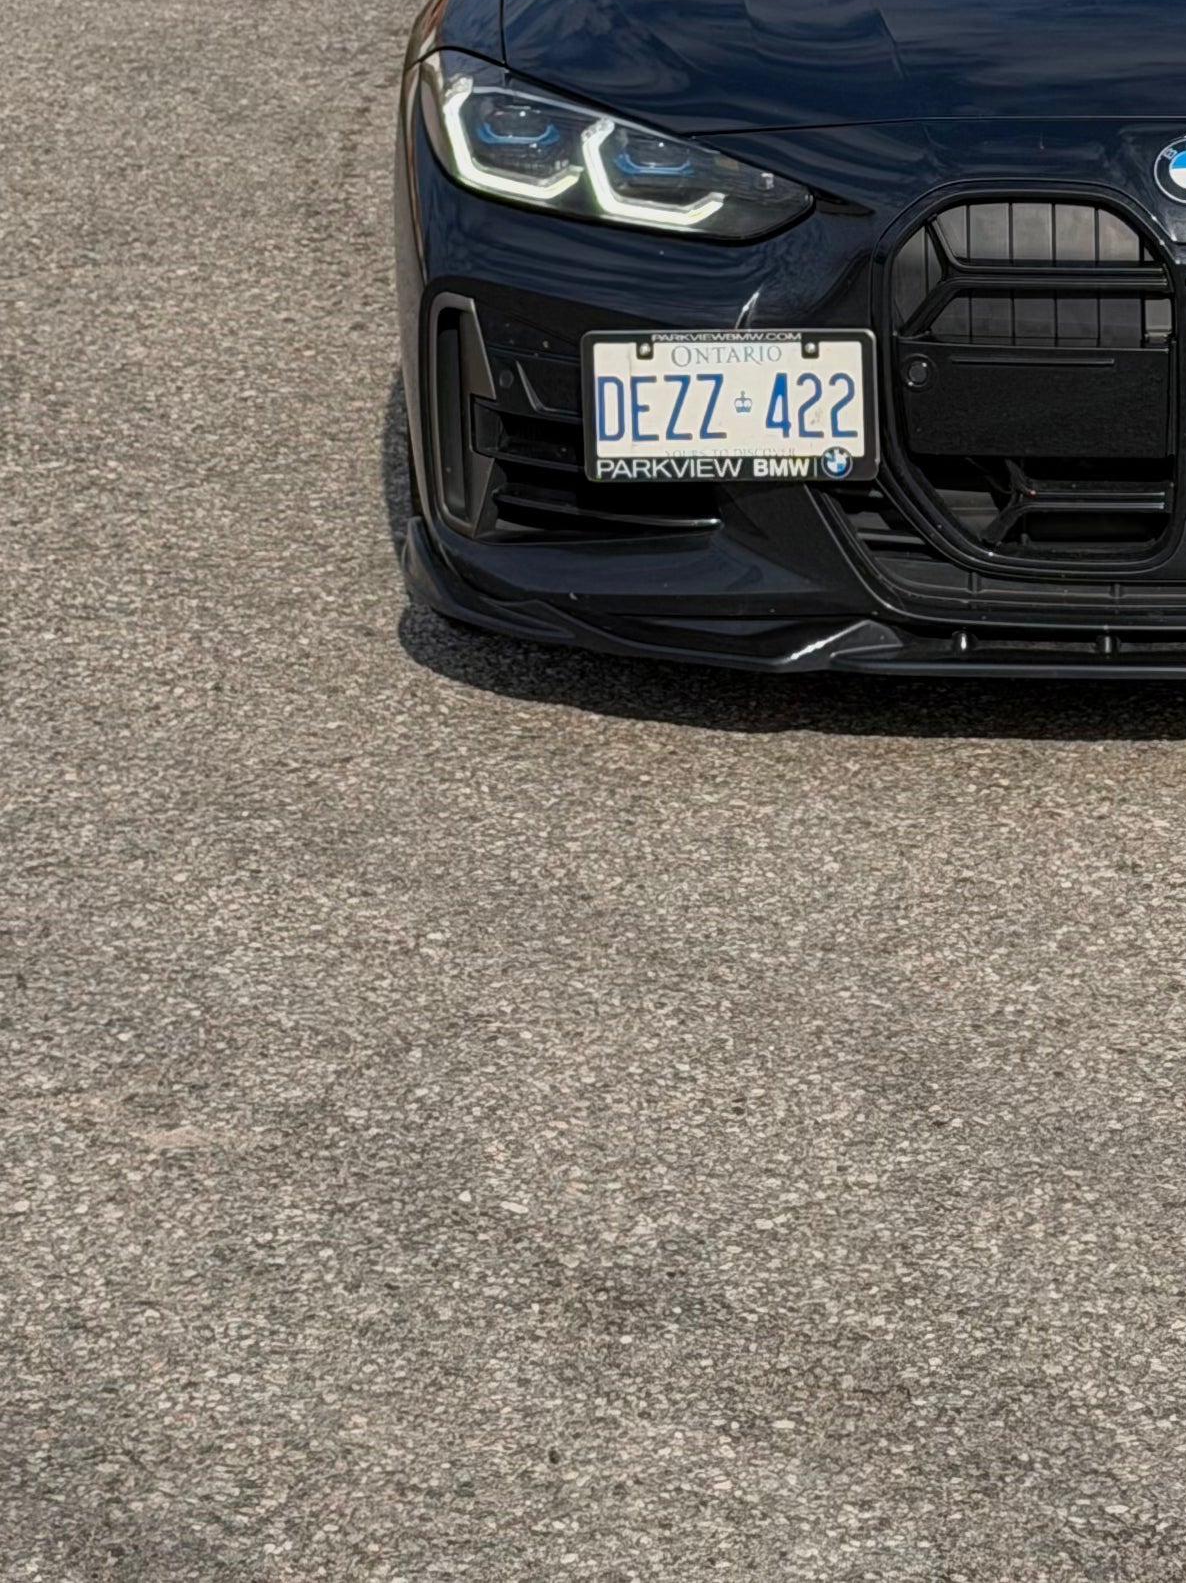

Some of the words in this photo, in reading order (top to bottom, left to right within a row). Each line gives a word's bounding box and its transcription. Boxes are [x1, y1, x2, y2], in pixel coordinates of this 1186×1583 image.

[651, 331, 802, 342] PARKVIEWBMW.COM
[597, 373, 727, 441] DEZZ
[765, 372, 858, 439] 422
[596, 458, 743, 479] PARKVIEW
[753, 458, 810, 478] BMW
